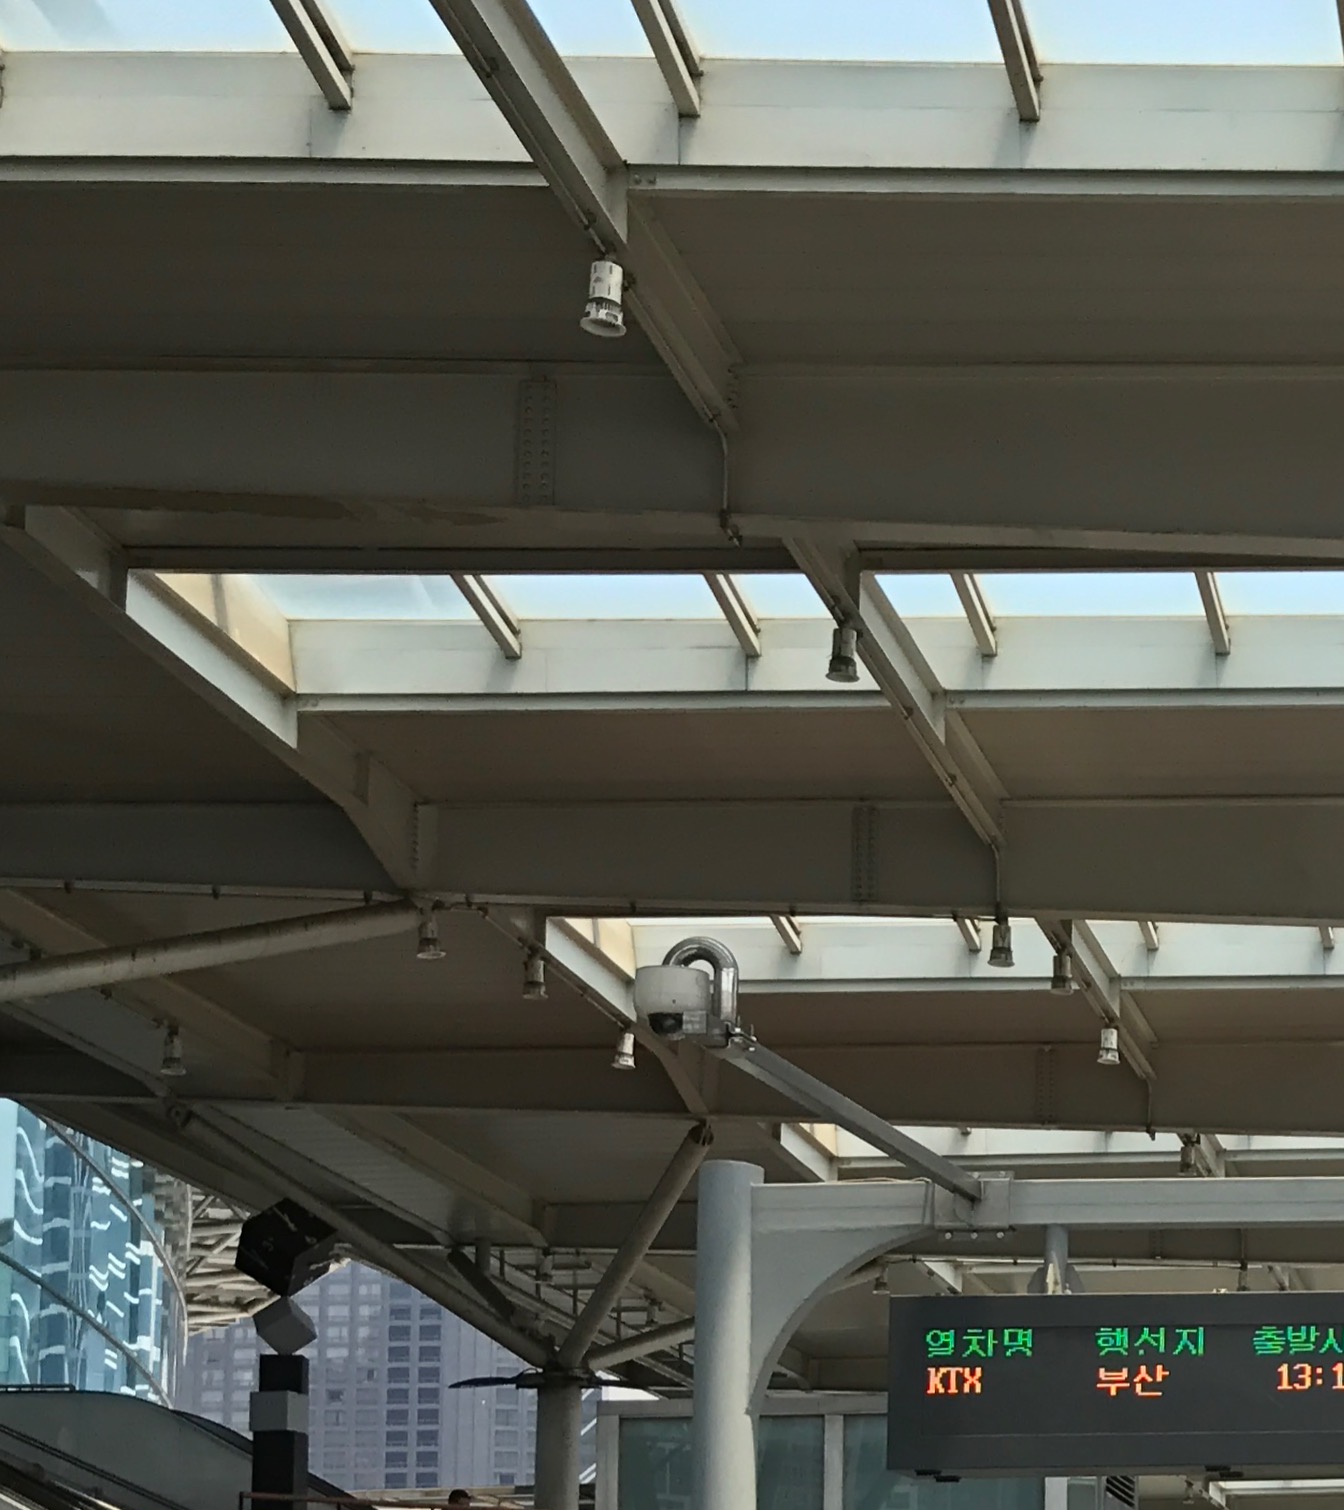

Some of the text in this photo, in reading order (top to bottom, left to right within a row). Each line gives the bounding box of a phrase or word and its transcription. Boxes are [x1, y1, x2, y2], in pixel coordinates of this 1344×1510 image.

[926, 1328, 1034, 1359] 열차명
[1095, 1325, 1205, 1357] 행선지
[926, 1366, 984, 1395] KTX
[1095, 1364, 1170, 1397] 부산
